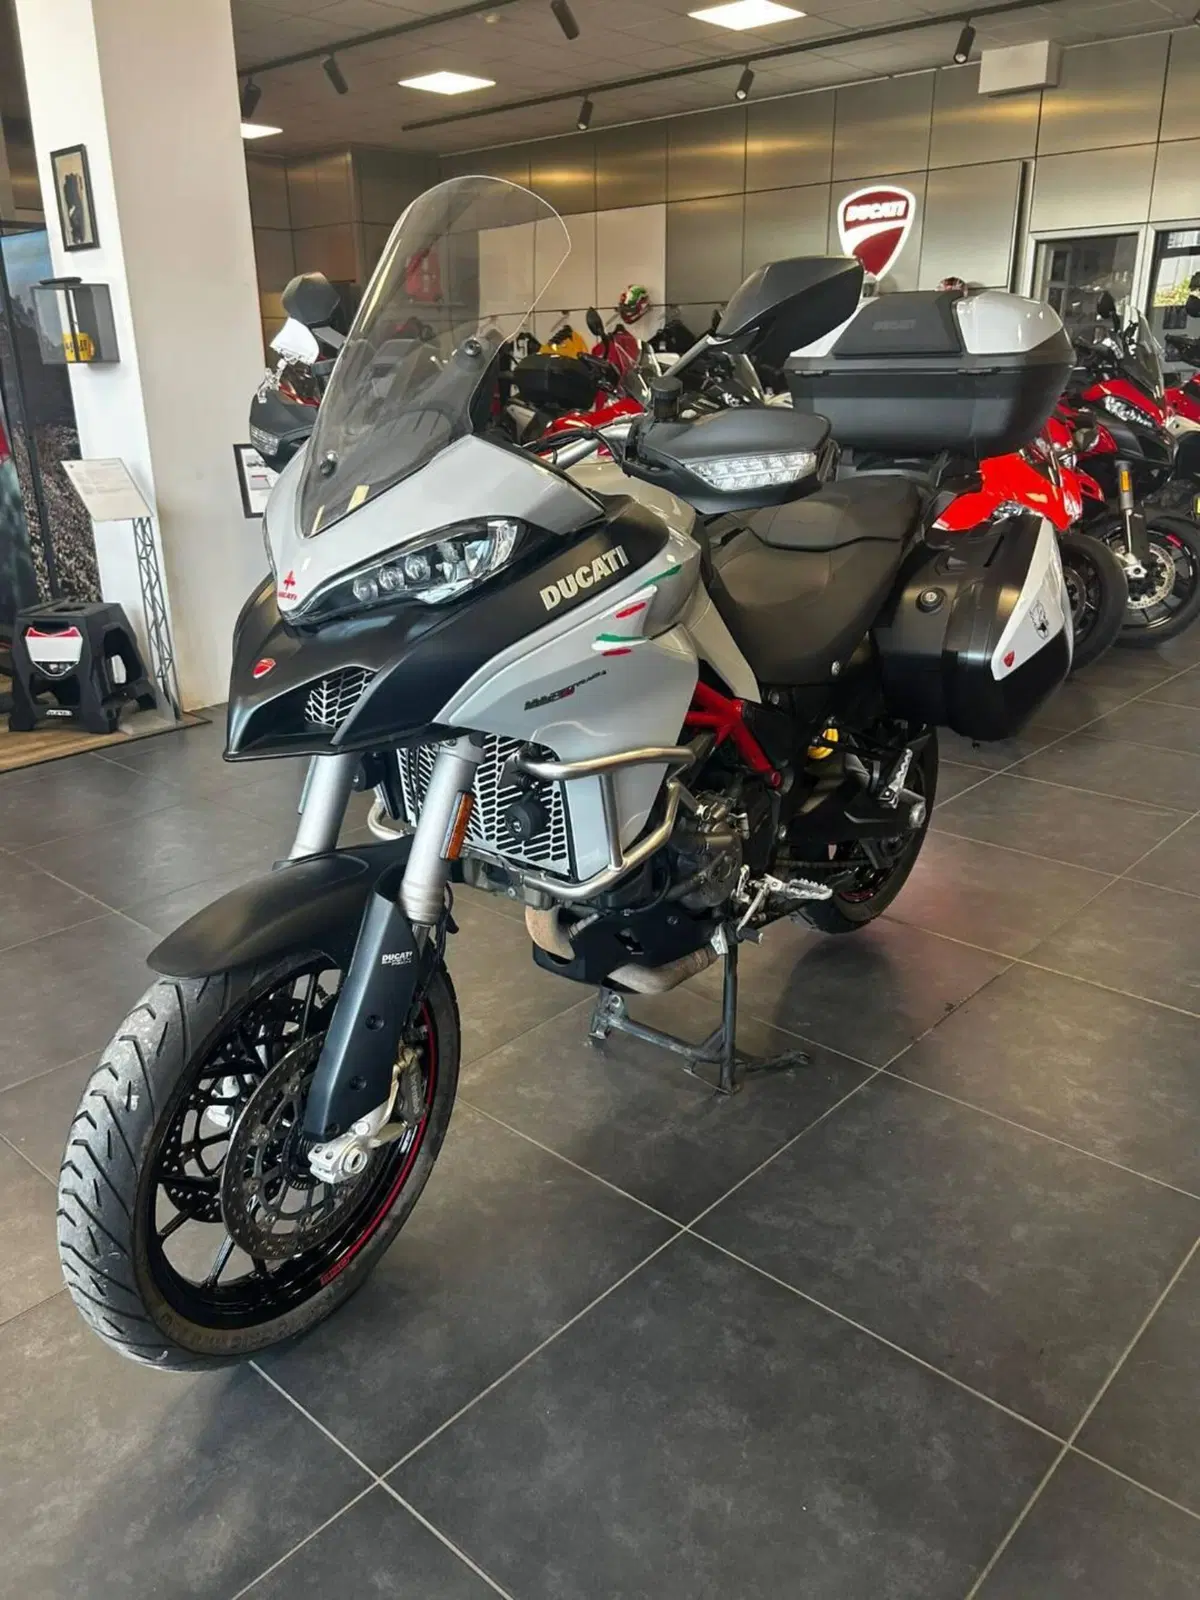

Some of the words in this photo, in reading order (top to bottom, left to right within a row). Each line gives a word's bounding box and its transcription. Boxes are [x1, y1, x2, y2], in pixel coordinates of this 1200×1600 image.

[845, 200, 907, 221] DUCATI
[539, 545, 630, 611] DUCATI
[382, 951, 413, 961] DUCATI
